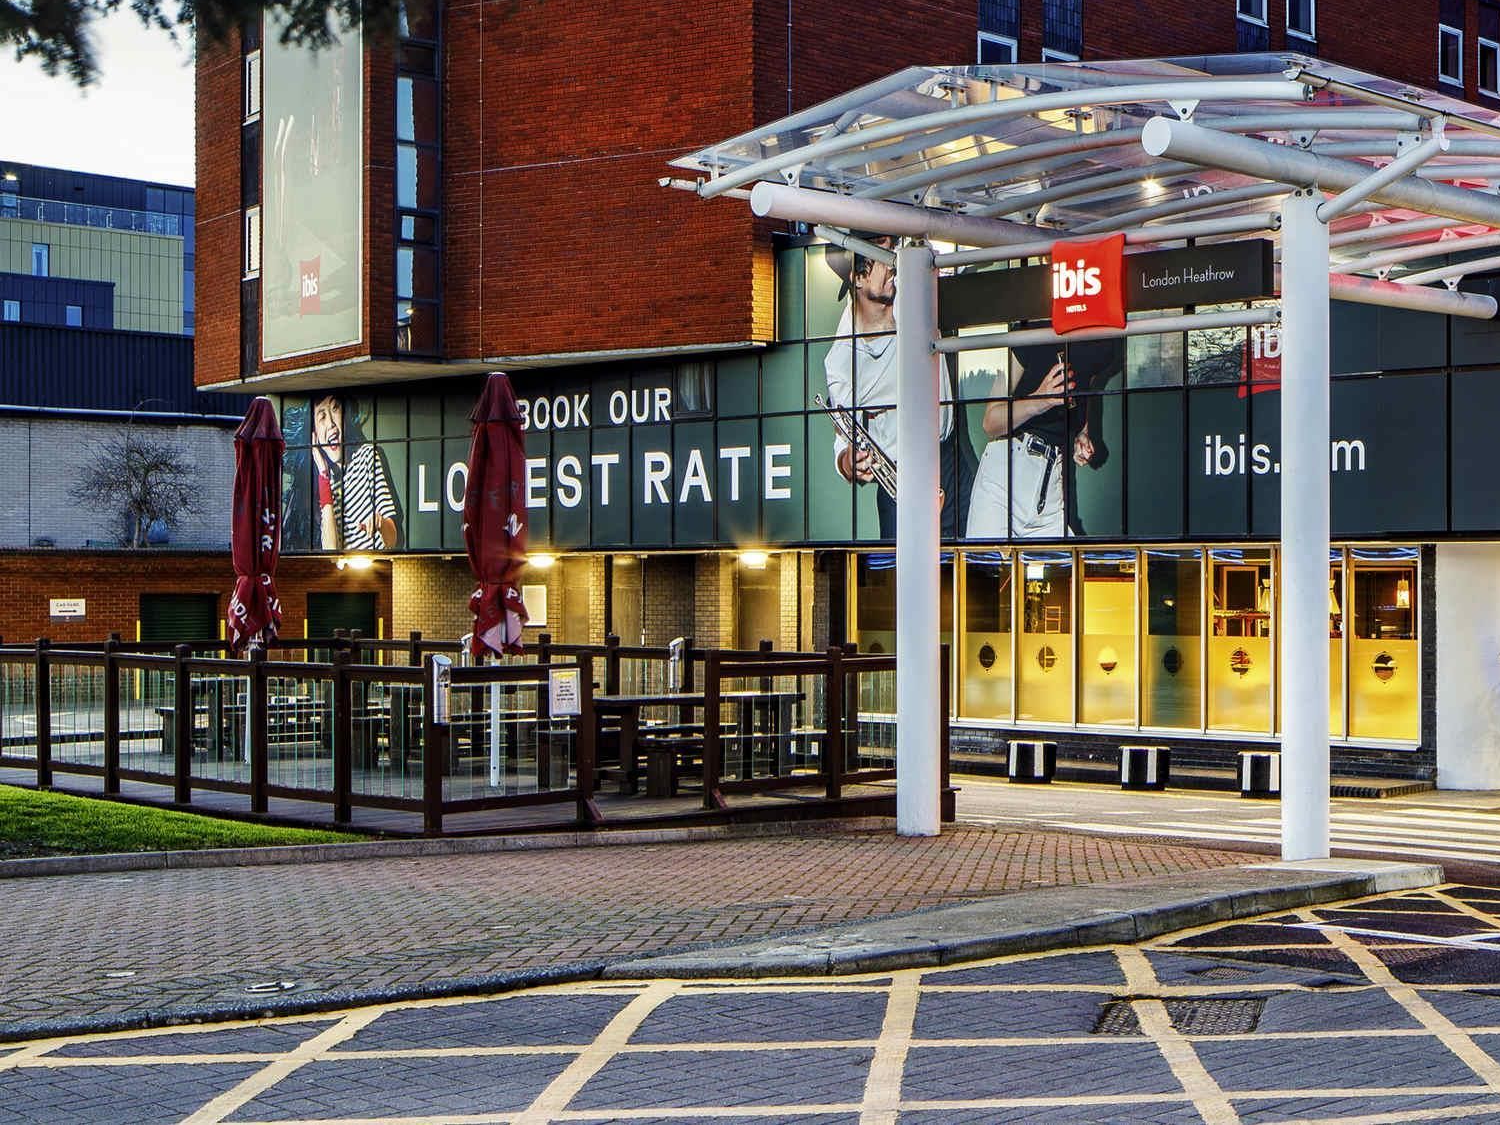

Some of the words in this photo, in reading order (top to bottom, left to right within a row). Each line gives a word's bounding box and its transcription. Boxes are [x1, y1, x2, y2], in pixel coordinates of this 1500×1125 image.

[302, 272, 318, 298] ibis
[1053, 259, 1102, 299] ibis
[1142, 269, 1181, 289] London
[1184, 265, 1236, 284] Heathrow
[515, 393, 590, 431] BOOK
[610, 387, 672, 425] OUR
[1205, 434, 1366, 475] ibis.m
[418, 454, 620, 512] LOEST
[644, 444, 792, 505] RATE
